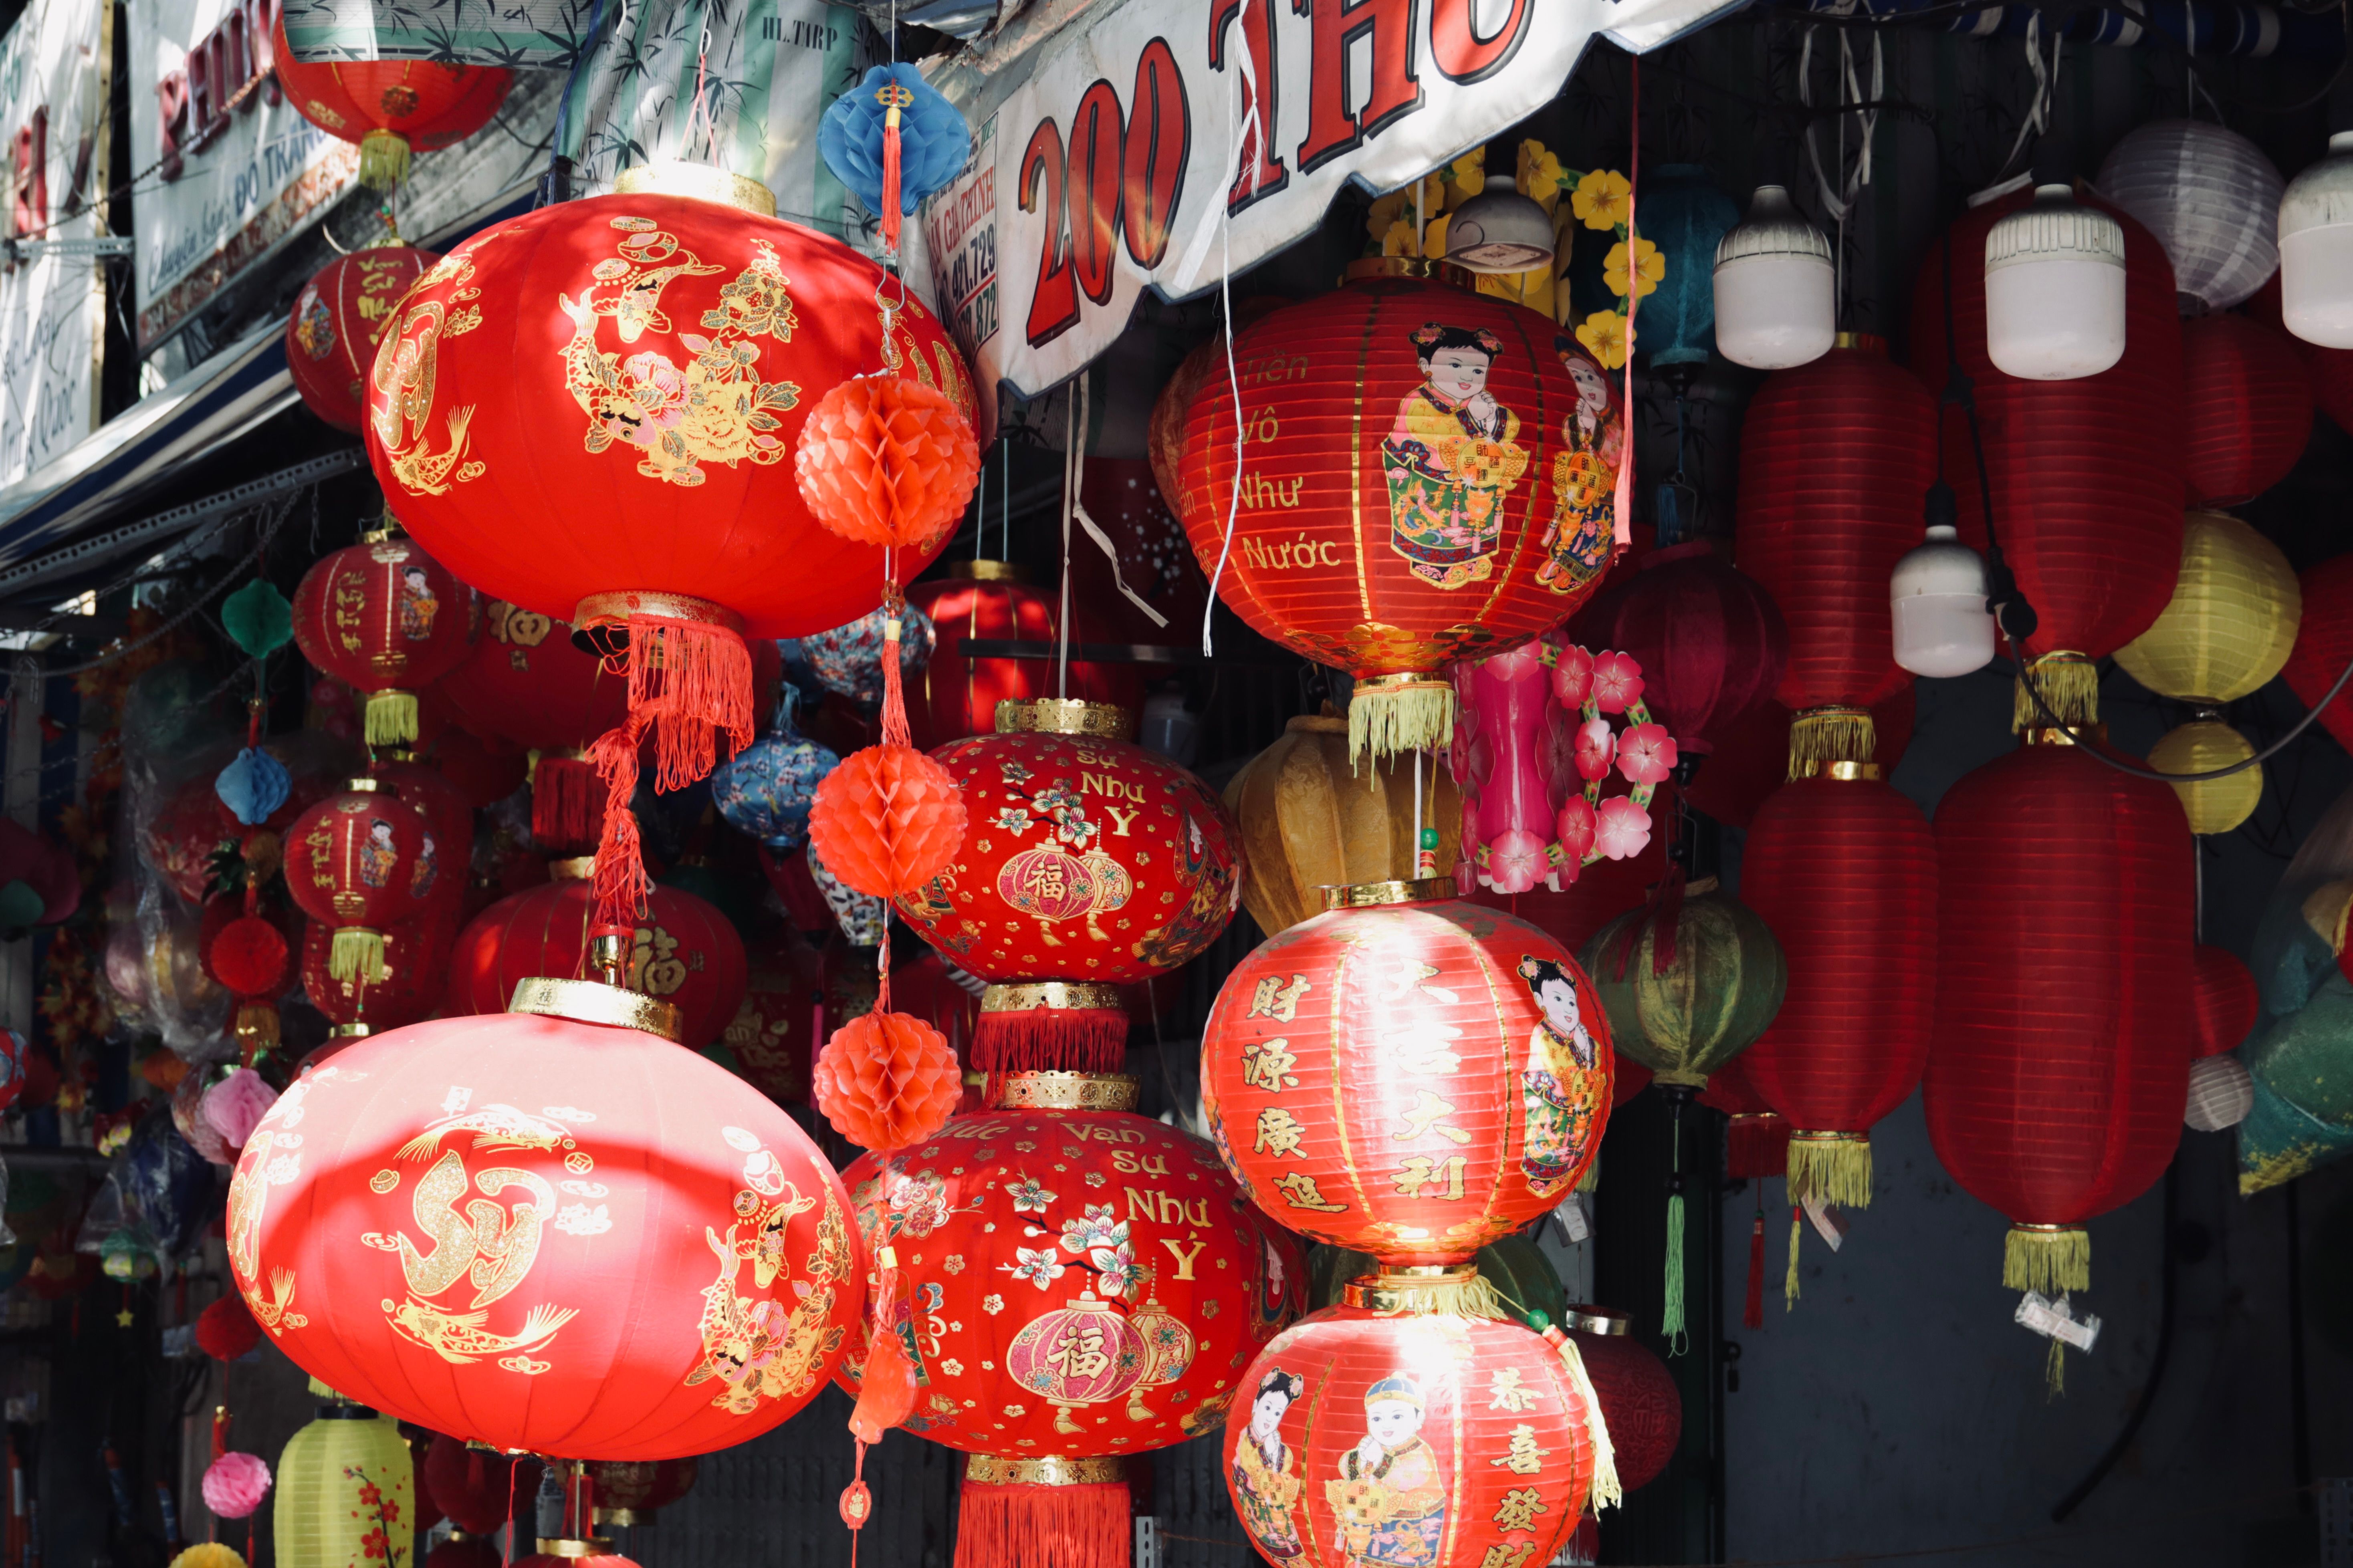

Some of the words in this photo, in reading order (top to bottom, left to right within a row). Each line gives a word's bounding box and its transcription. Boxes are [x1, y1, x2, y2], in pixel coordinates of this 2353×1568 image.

[763, 17, 837, 51] HL.TARP
[1018, 36, 1191, 349] 200
[1243, 349, 1309, 385] Tiền
[1240, 405, 1279, 445] Vô
[1231, 471, 1304, 509] Như
[1243, 532, 1340, 569] Nước
[1104, 802, 1140, 837] Ý
[1024, 861, 1068, 903] 福
[1059, 1122, 1146, 1145] Vạn
[1123, 1186, 1214, 1228] Như
[1159, 1230, 1207, 1281] Ý
[1046, 1325, 1110, 1380] 福
